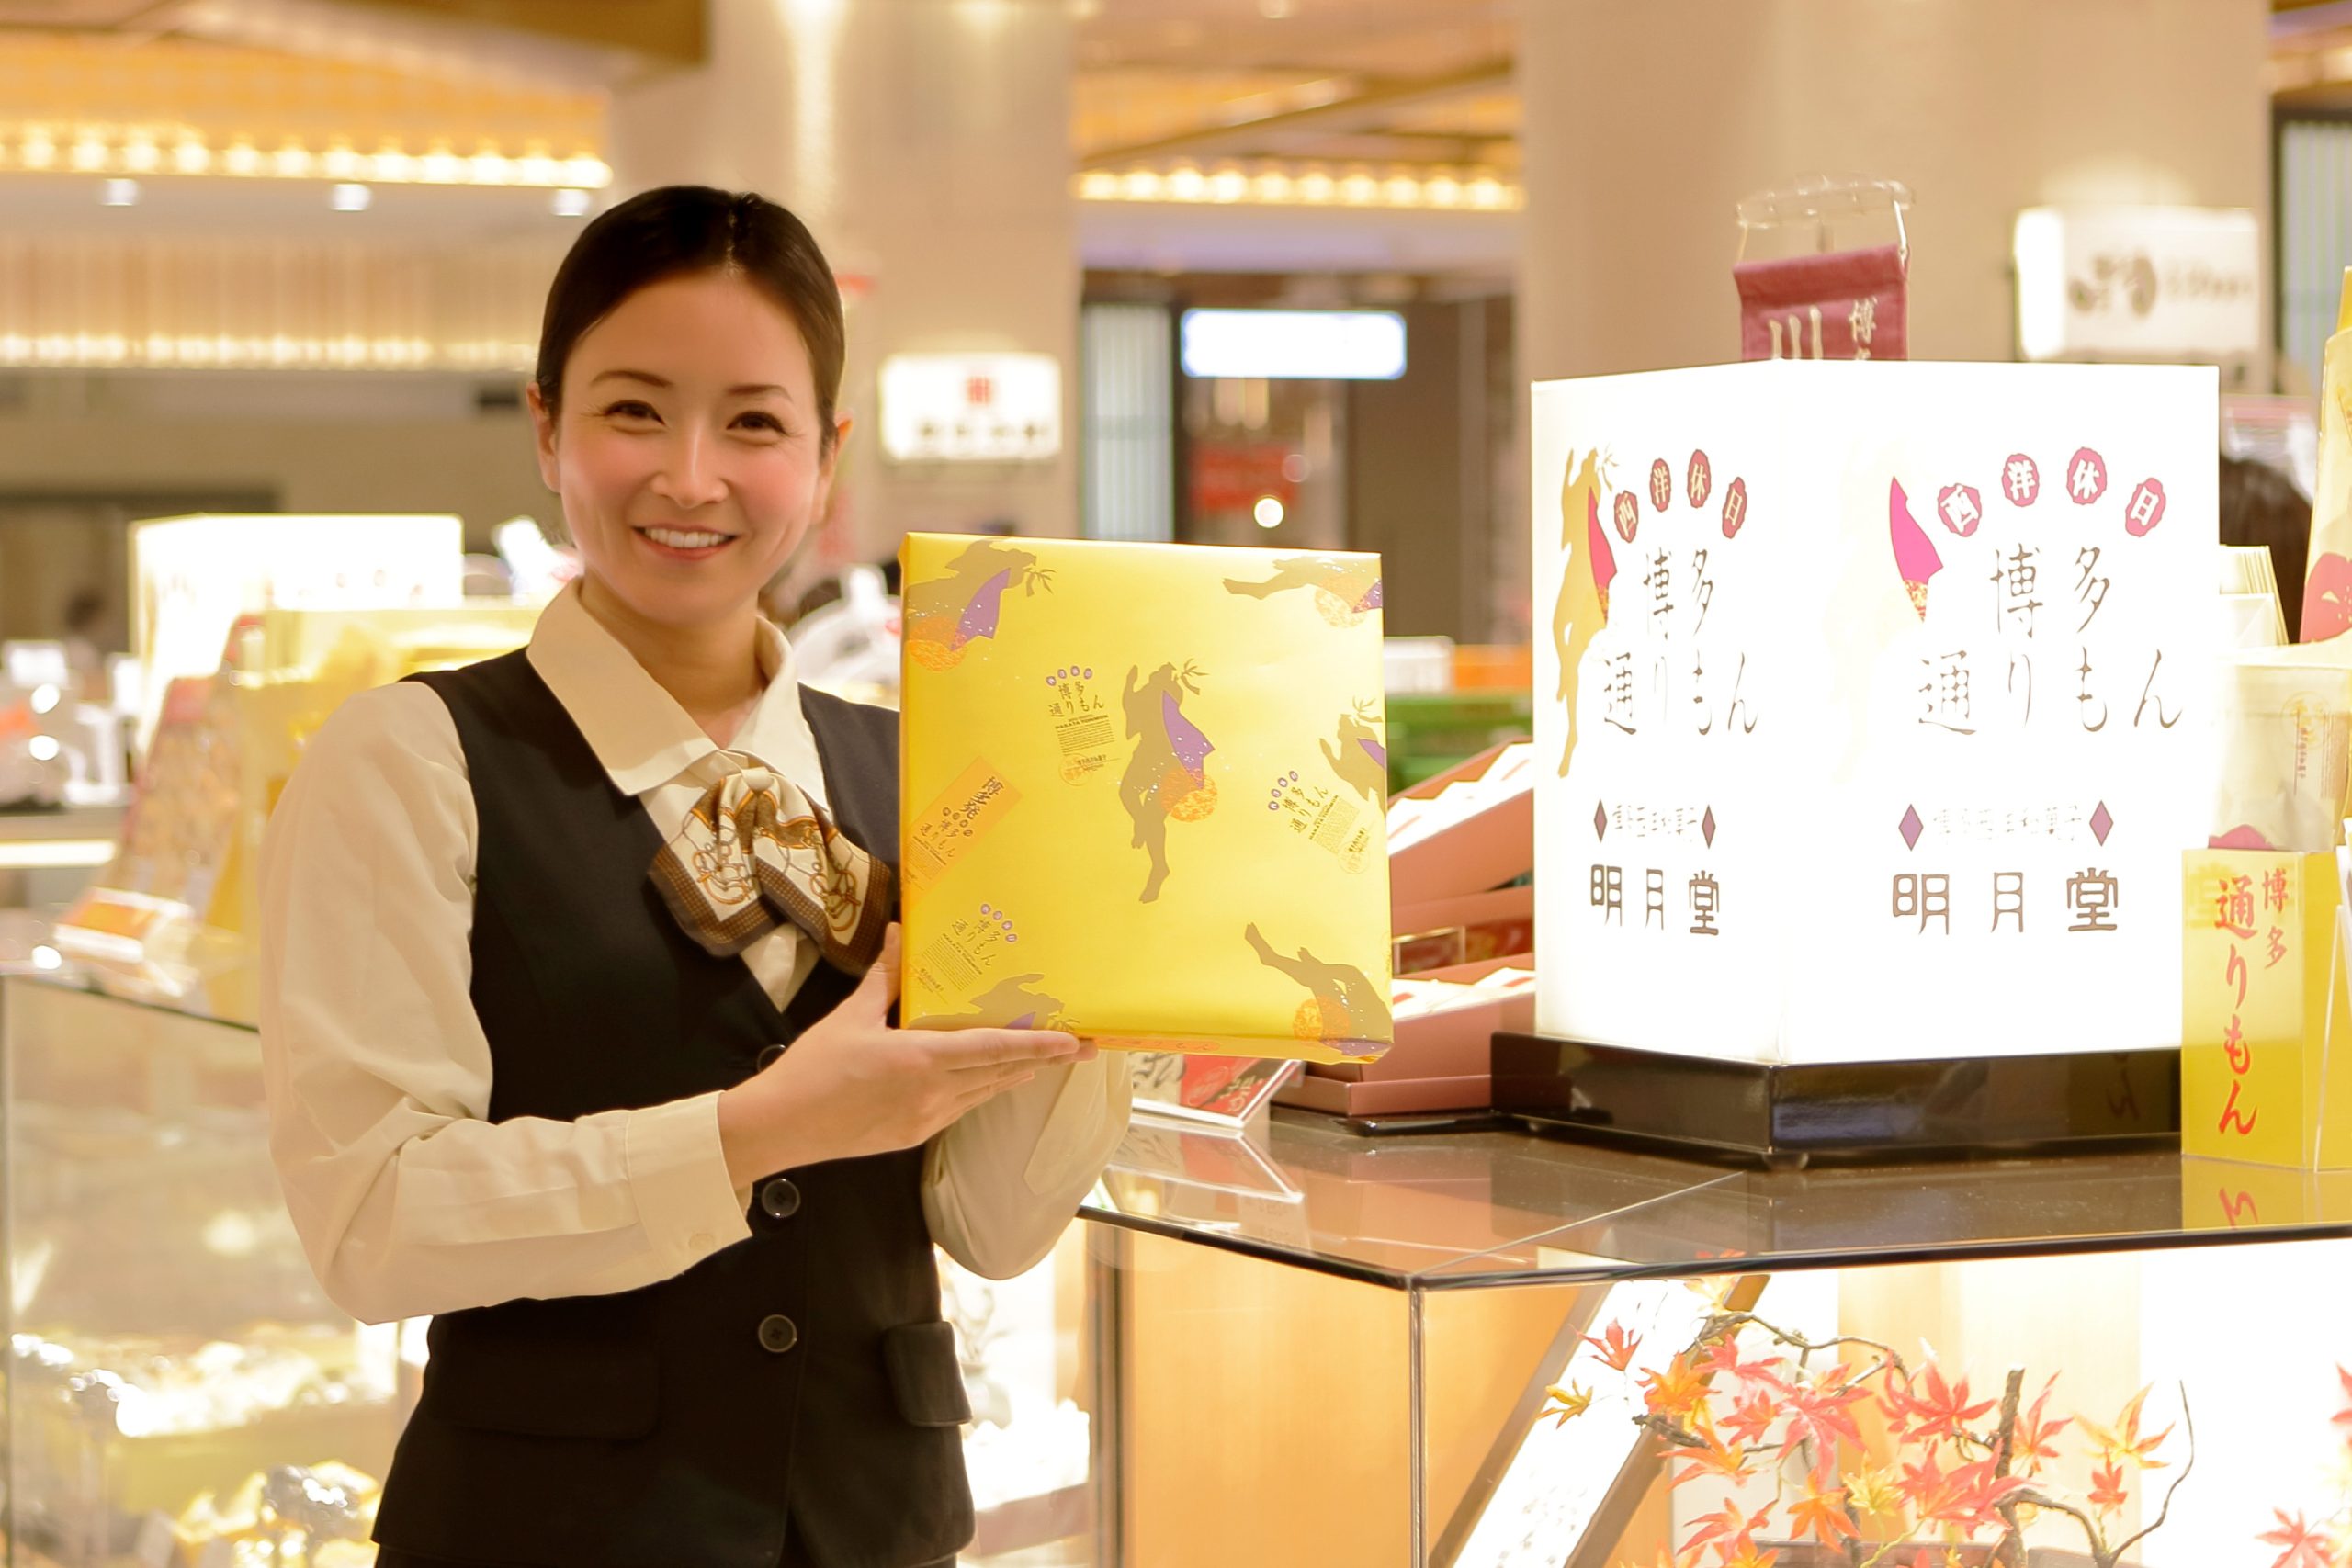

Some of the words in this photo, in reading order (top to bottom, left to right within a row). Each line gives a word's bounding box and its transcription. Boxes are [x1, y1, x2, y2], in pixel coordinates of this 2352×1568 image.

[1642, 547, 1713, 640] 博多
[1990, 543, 2110, 639] 博多
[1048, 694, 1104, 717] 通りもん
[1604, 648, 1759, 736] 通りもん
[1918, 645, 2184, 736] 通りもん
[1590, 864, 1720, 936] 明月堂
[1892, 867, 2118, 935] 明月堂
[2262, 867, 2288, 969] 博多
[2214, 874, 2259, 1135] 通りもん
